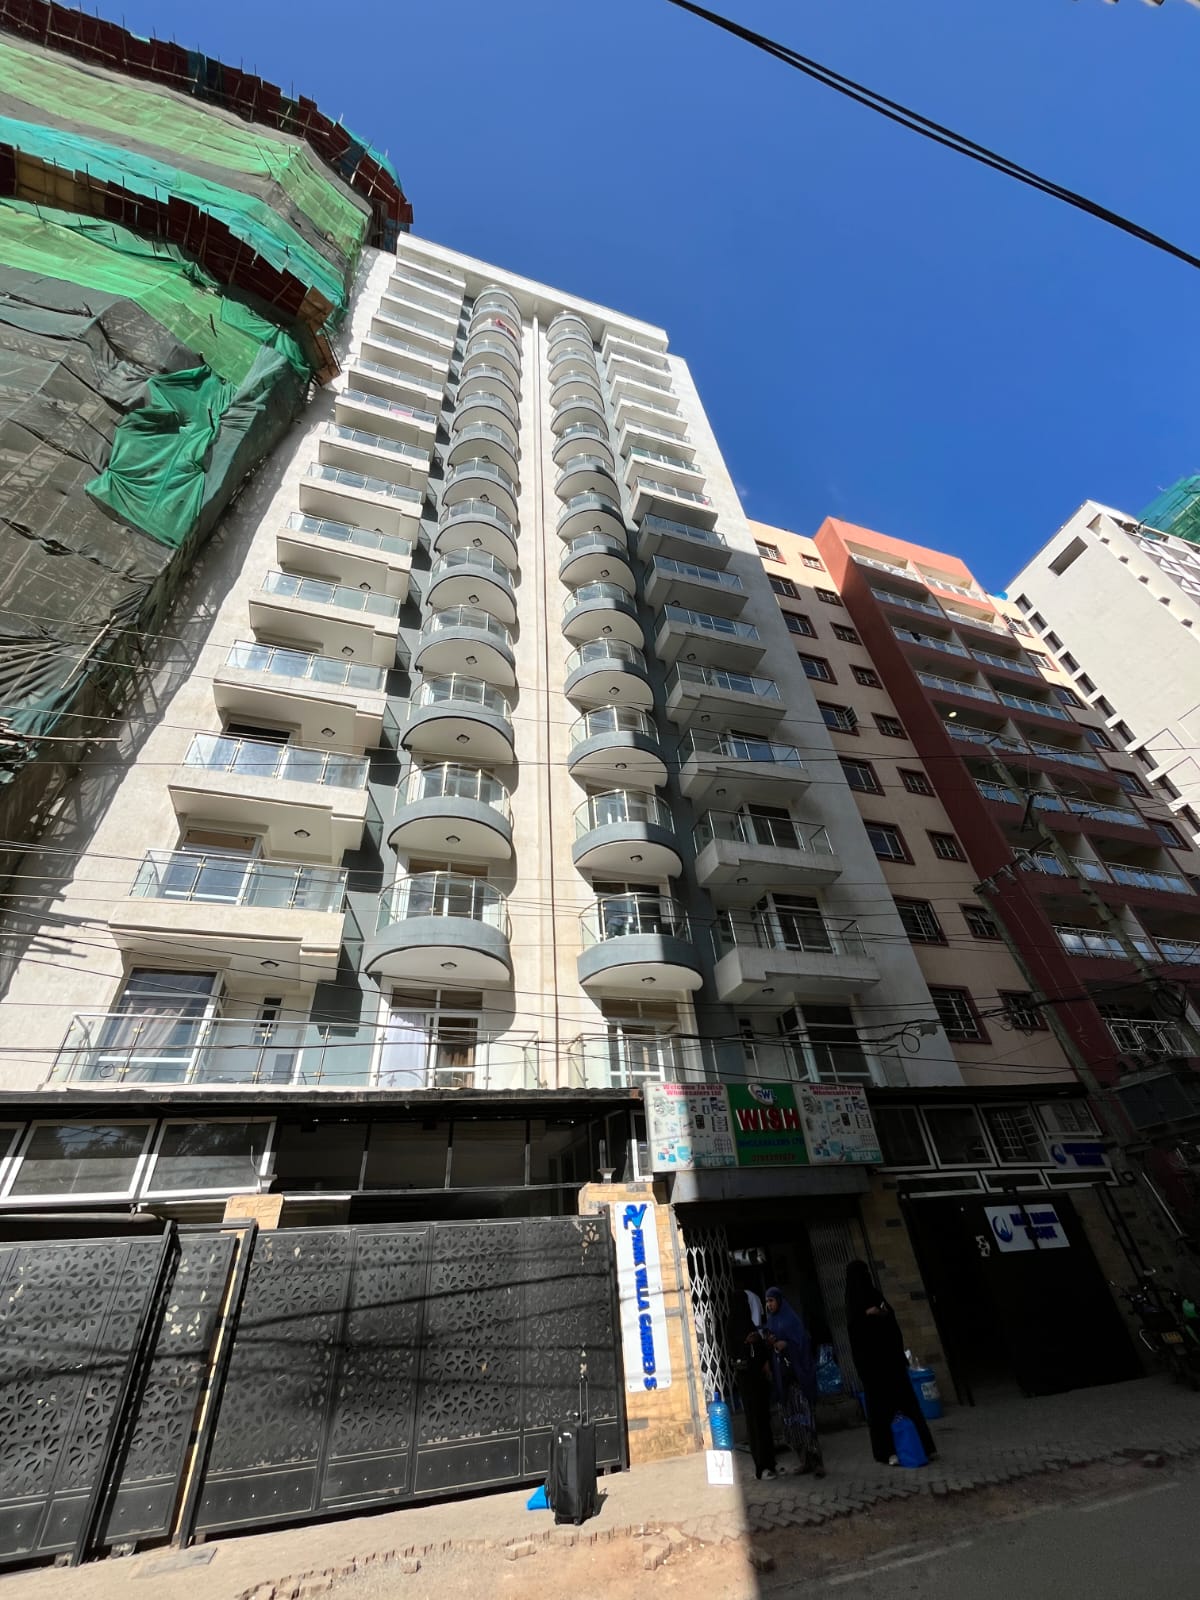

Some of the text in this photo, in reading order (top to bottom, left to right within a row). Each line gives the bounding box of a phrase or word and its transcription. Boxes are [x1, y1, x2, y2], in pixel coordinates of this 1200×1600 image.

[735, 1107, 800, 1131] WISH
[631, 1229, 646, 1266] PARK
[635, 1268, 650, 1311] VILLA
